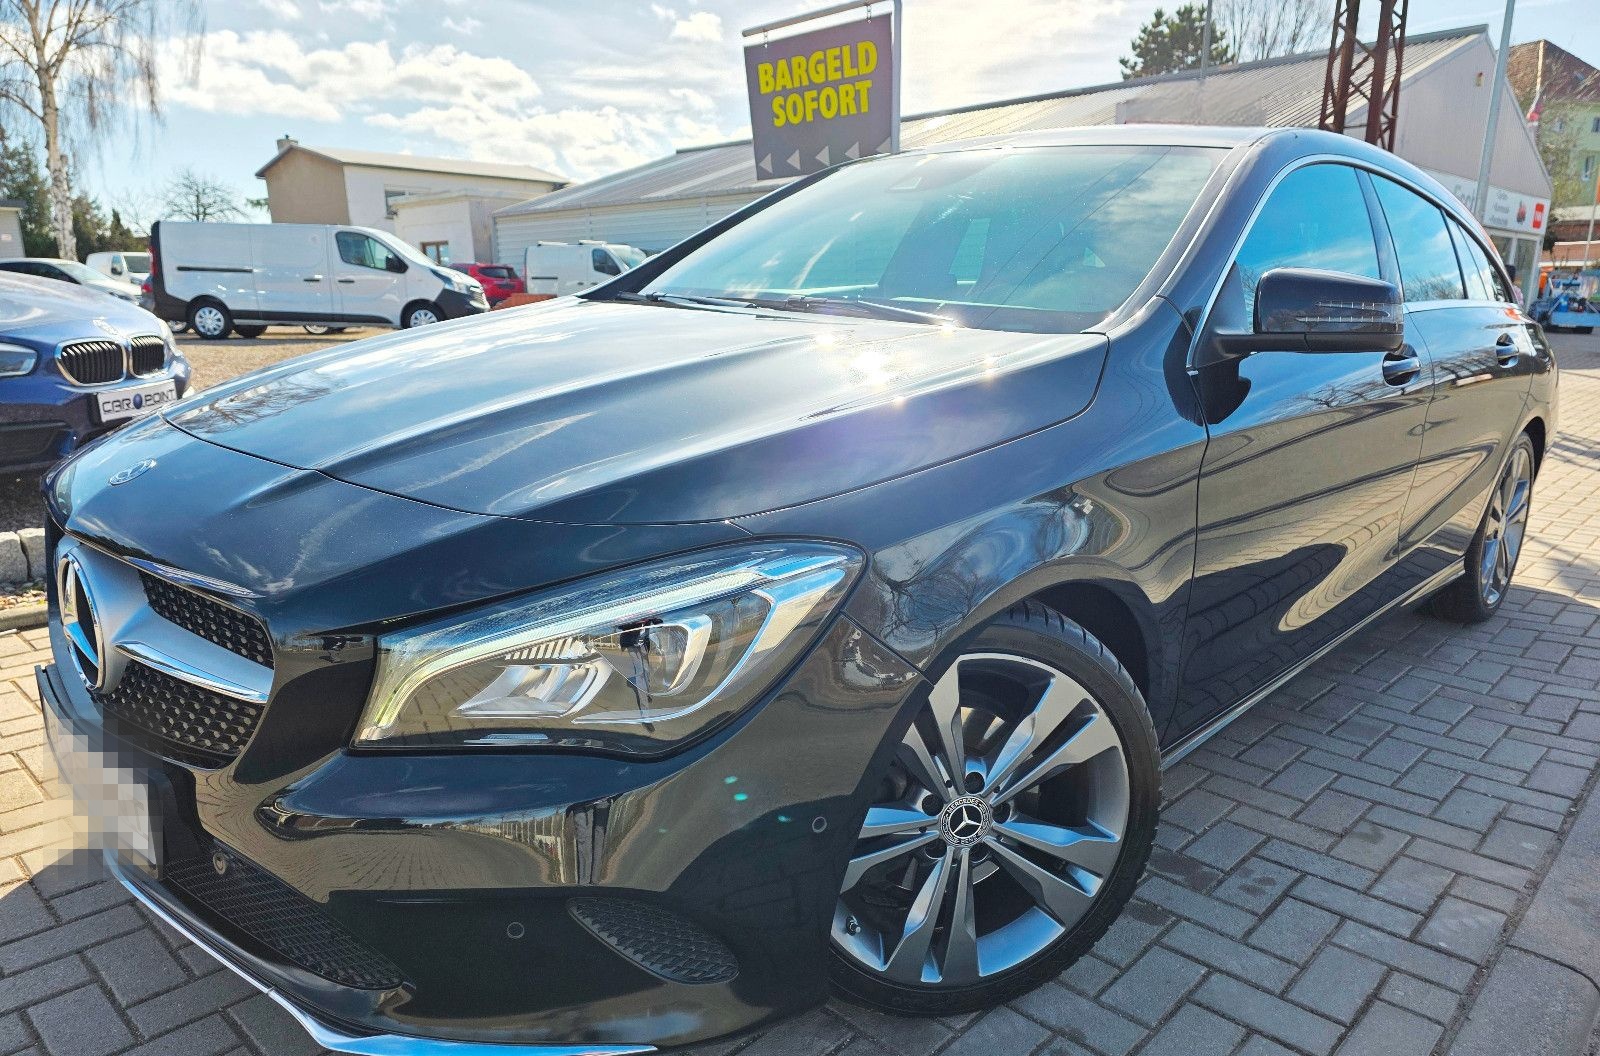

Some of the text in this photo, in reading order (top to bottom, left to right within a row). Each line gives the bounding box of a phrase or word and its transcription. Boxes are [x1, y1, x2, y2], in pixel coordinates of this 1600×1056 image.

[758, 41, 878, 94] BARGELD
[772, 80, 872, 127] SOFORT
[102, 389, 175, 414] CAR POINT
[948, 798, 979, 813] MERCEDES
